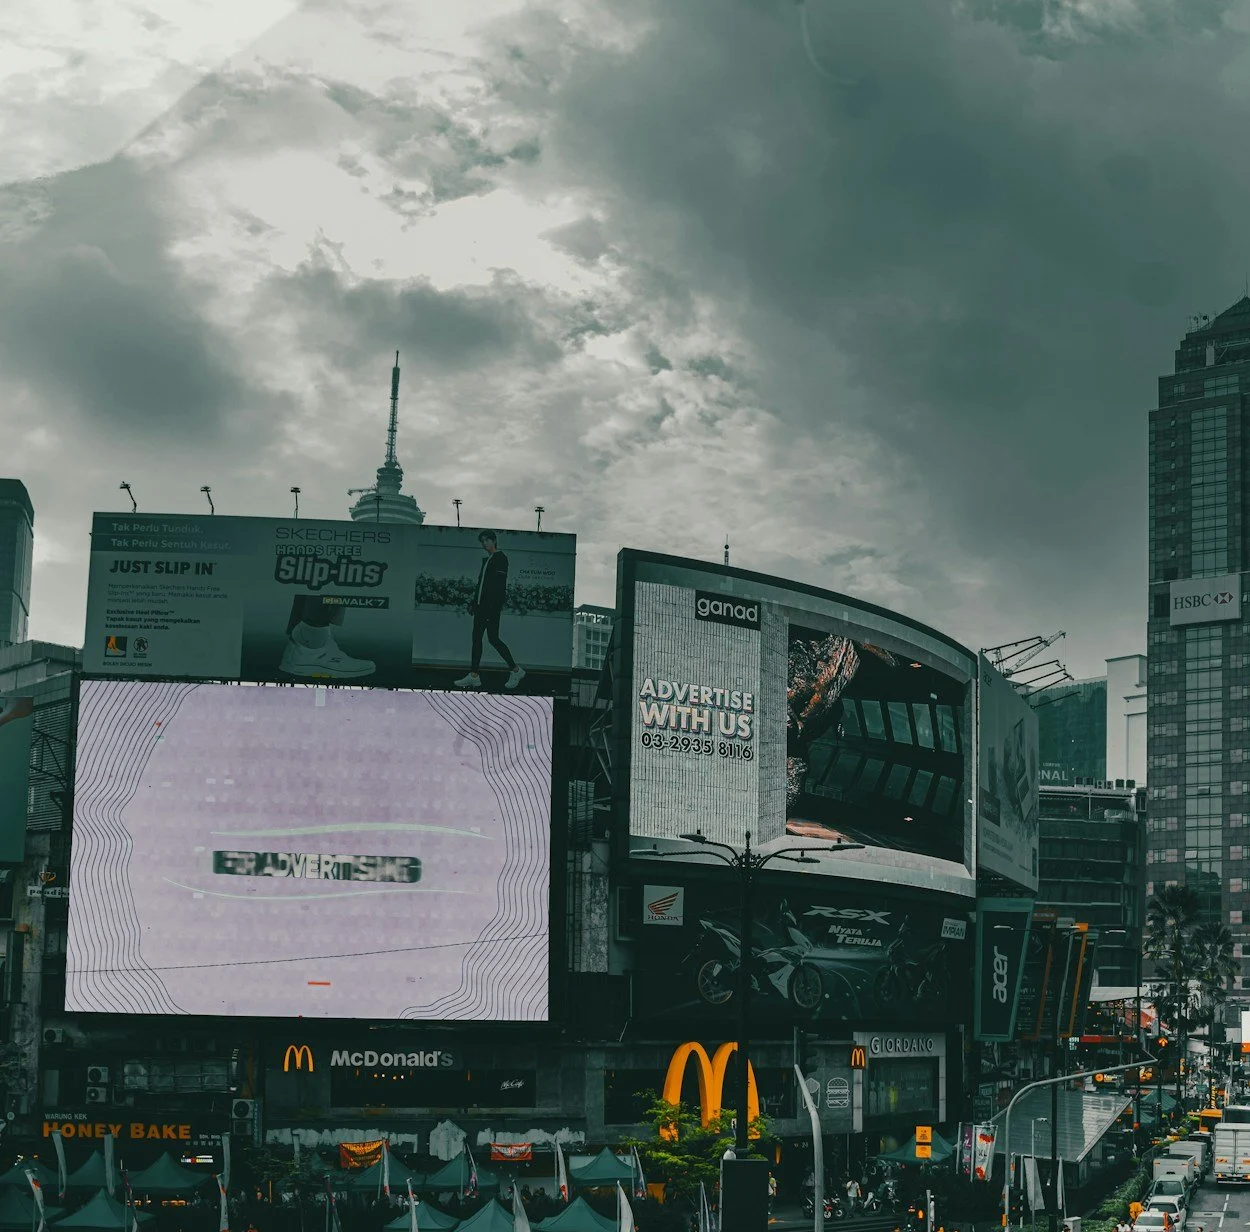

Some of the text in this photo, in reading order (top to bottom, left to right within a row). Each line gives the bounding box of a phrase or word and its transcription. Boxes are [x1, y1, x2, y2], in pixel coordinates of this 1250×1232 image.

[112, 523, 204, 534] Tak Perlu Tunduk.
[276, 527, 391, 544] SKECHERS
[111, 538, 129, 547] Tak
[132, 538, 158, 548] Perlu
[161, 540, 197, 549] Sentuh
[276, 545, 362, 557] HANDS FREE
[109, 560, 151, 574] JUST
[155, 561, 191, 575] SLIP
[377, 599, 386, 607] 7
[697, 595, 758, 623] ganad
[1174, 594, 1211, 610] HSBC
[640, 678, 754, 712] ADVERTISE
[639, 702, 752, 739] WITH US
[641, 732, 753, 760] 03-2935 8116
[1039, 770, 1069, 781] NAL
[828, 925, 863, 936] NYATA
[836, 934, 882, 947] TERUJA
[992, 946, 1009, 1004] acer
[870, 1036, 934, 1054] GIORDANO
[330, 1050, 454, 1067] McDonald's
[42, 1122, 192, 1140] HONEY BAKE
